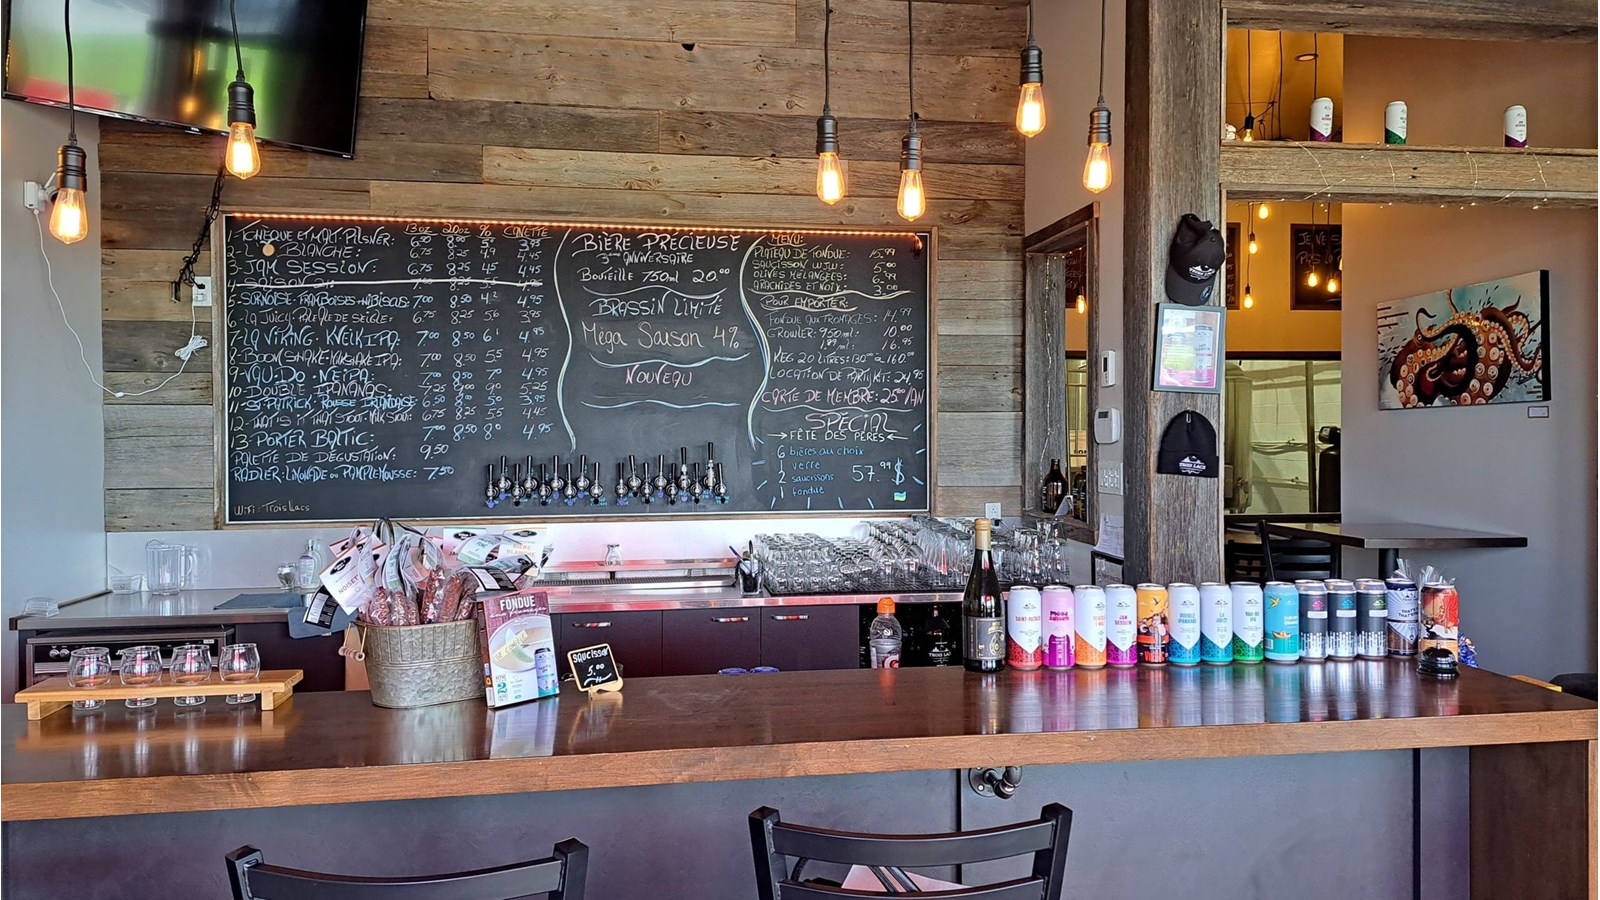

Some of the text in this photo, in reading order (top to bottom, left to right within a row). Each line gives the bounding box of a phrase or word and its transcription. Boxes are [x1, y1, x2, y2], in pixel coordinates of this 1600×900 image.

[572, 232, 741, 257] BIÈRE PRÉCIEUSE
[623, 251, 694, 266] ANNIVERSAIRE
[753, 246, 791, 259] PLATEAU
[792, 249, 808, 259] DE
[243, 258, 279, 277] JAM
[286, 258, 379, 275] SESSION:
[752, 260, 809, 271] SAUCISSON
[752, 270, 786, 280] OLIVES
[753, 282, 802, 292] ARACHIDES
[805, 283, 816, 291] ET
[589, 290, 724, 319] BRASSIN LIMITÉ
[760, 295, 849, 308] POUR EMPORTER:
[766, 309, 802, 327] FONDUE
[638, 321, 706, 349] Saison
[713, 326, 740, 349] 4%
[773, 346, 794, 364] KEG
[797, 353, 815, 364] 20
[626, 363, 692, 388] NOUVEAU
[769, 366, 824, 380] LOCATION
[828, 371, 842, 382] DE
[761, 387, 800, 405] CARTE
[805, 390, 822, 404] DE
[805, 411, 898, 433] SPÉCIAL
[248, 427, 306, 449] PORTER
[310, 426, 376, 450] BALTIC:
[790, 428, 817, 441] FÊTE
[825, 430, 847, 441] DES
[231, 449, 280, 466] PALETTE
[284, 452, 310, 467] DE
[777, 445, 786, 459] 6
[789, 446, 817, 457] bières
[836, 446, 864, 456] choix
[791, 461, 821, 472] verre
[778, 470, 835, 484] 2 saucissons
[791, 486, 826, 497] fondue
[500, 596, 536, 611] FONDUE
